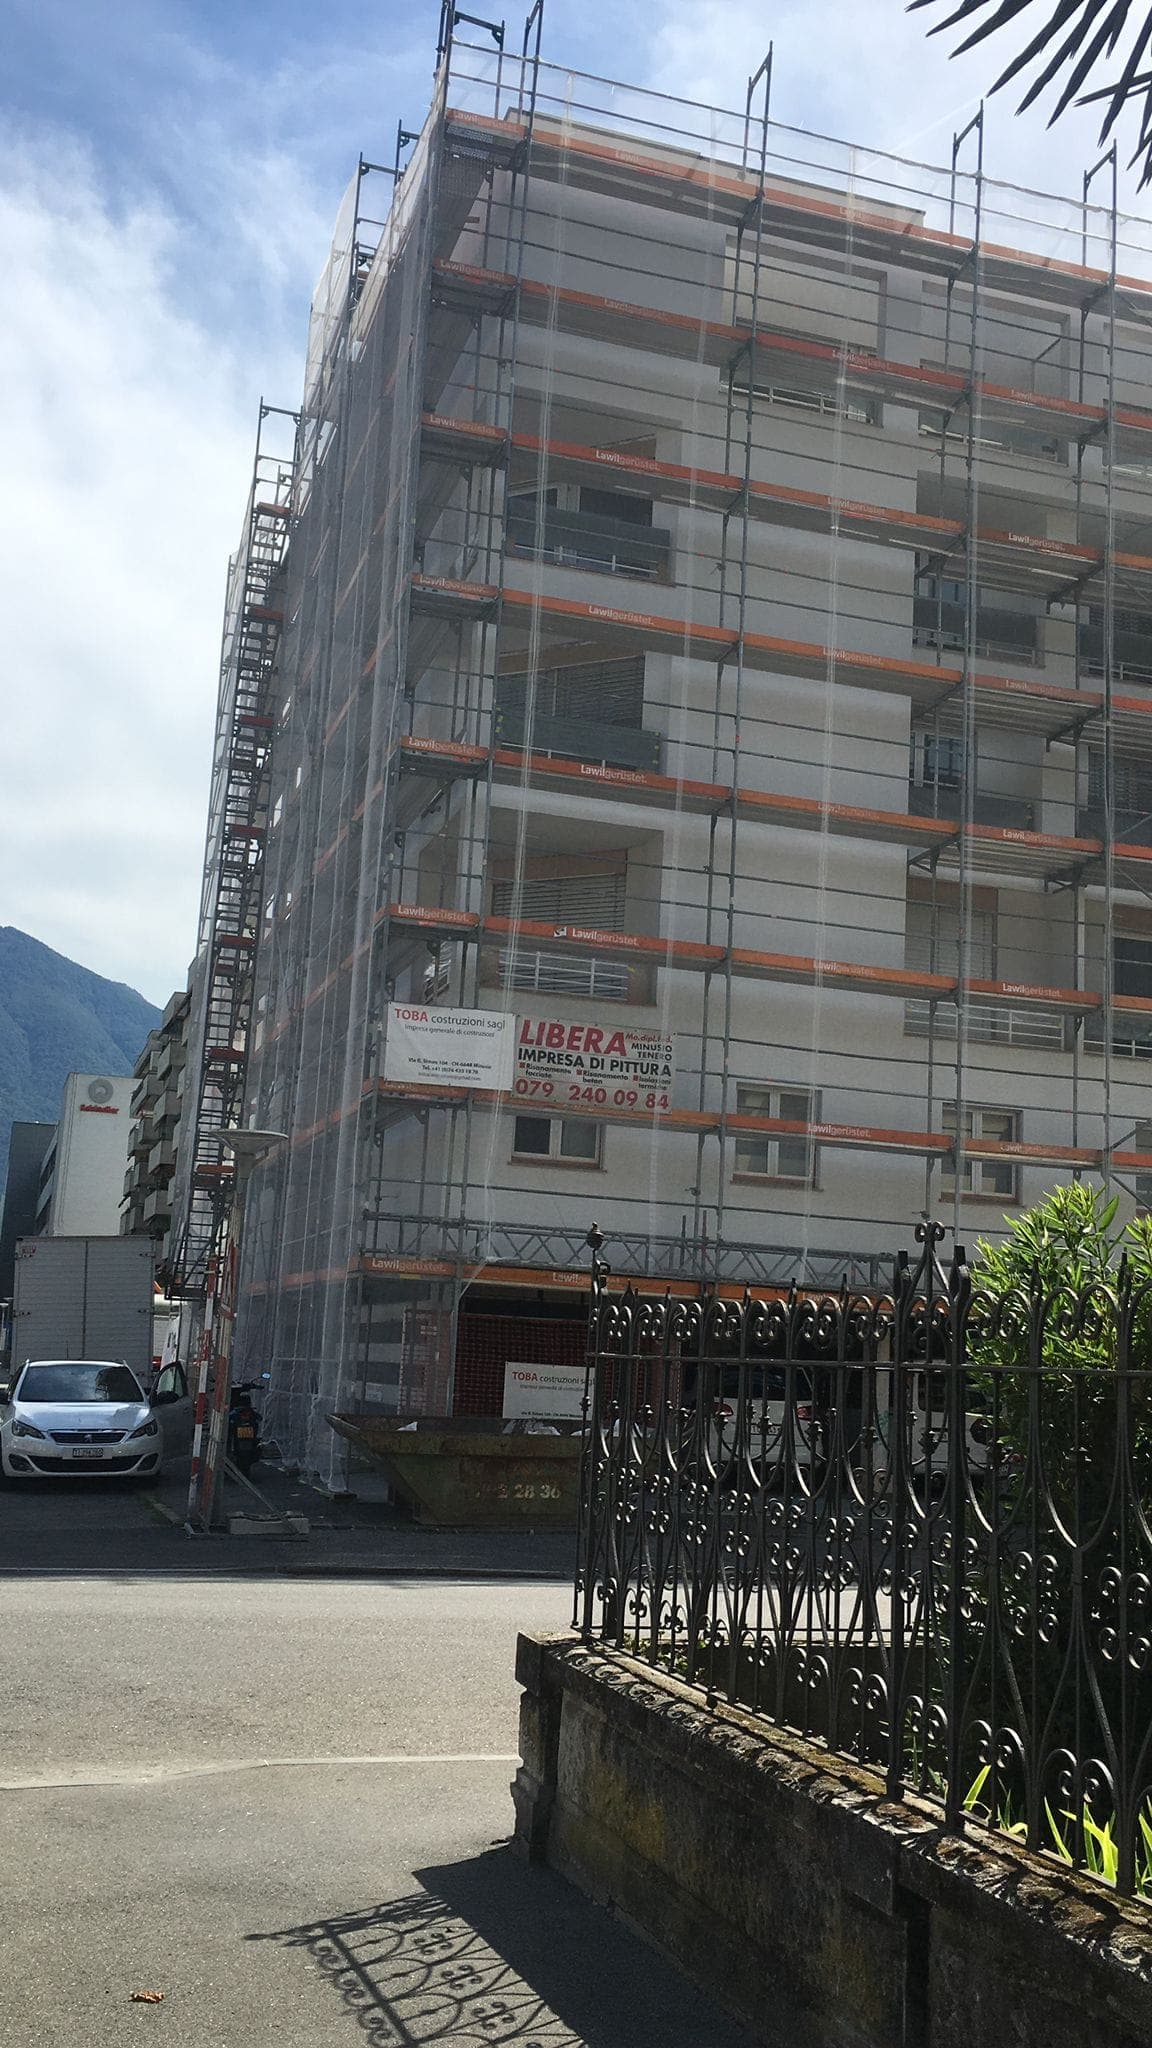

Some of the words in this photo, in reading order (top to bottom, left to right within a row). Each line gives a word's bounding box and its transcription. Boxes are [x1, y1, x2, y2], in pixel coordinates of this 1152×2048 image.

[394, 1008, 428, 1022] TOBA
[431, 1015, 485, 1027] costruzioni
[487, 1020, 505, 1031] sagl
[463, 1029, 495, 1038] costruzioni
[519, 1019, 627, 1057] LIBERA
[631, 1042, 673, 1053] MINUSIO
[637, 1051, 672, 1061] TENERO
[518, 1048, 585, 1069] IMPRESA
[590, 1057, 605, 1071] DI
[610, 1059, 672, 1077] PITTURA
[525, 1069, 553, 1079] facciate
[526, 1063, 572, 1075] Risanamento
[583, 1070, 629, 1081] Risanamento
[583, 1077, 603, 1085] beton
[515, 1078, 554, 1097] 079
[569, 1085, 607, 1104] 240
[613, 1089, 638, 1107] 09
[645, 1093, 669, 1110] 84
[512, 1371, 538, 1381] TOBA
[513, 1484, 536, 1499] 28
